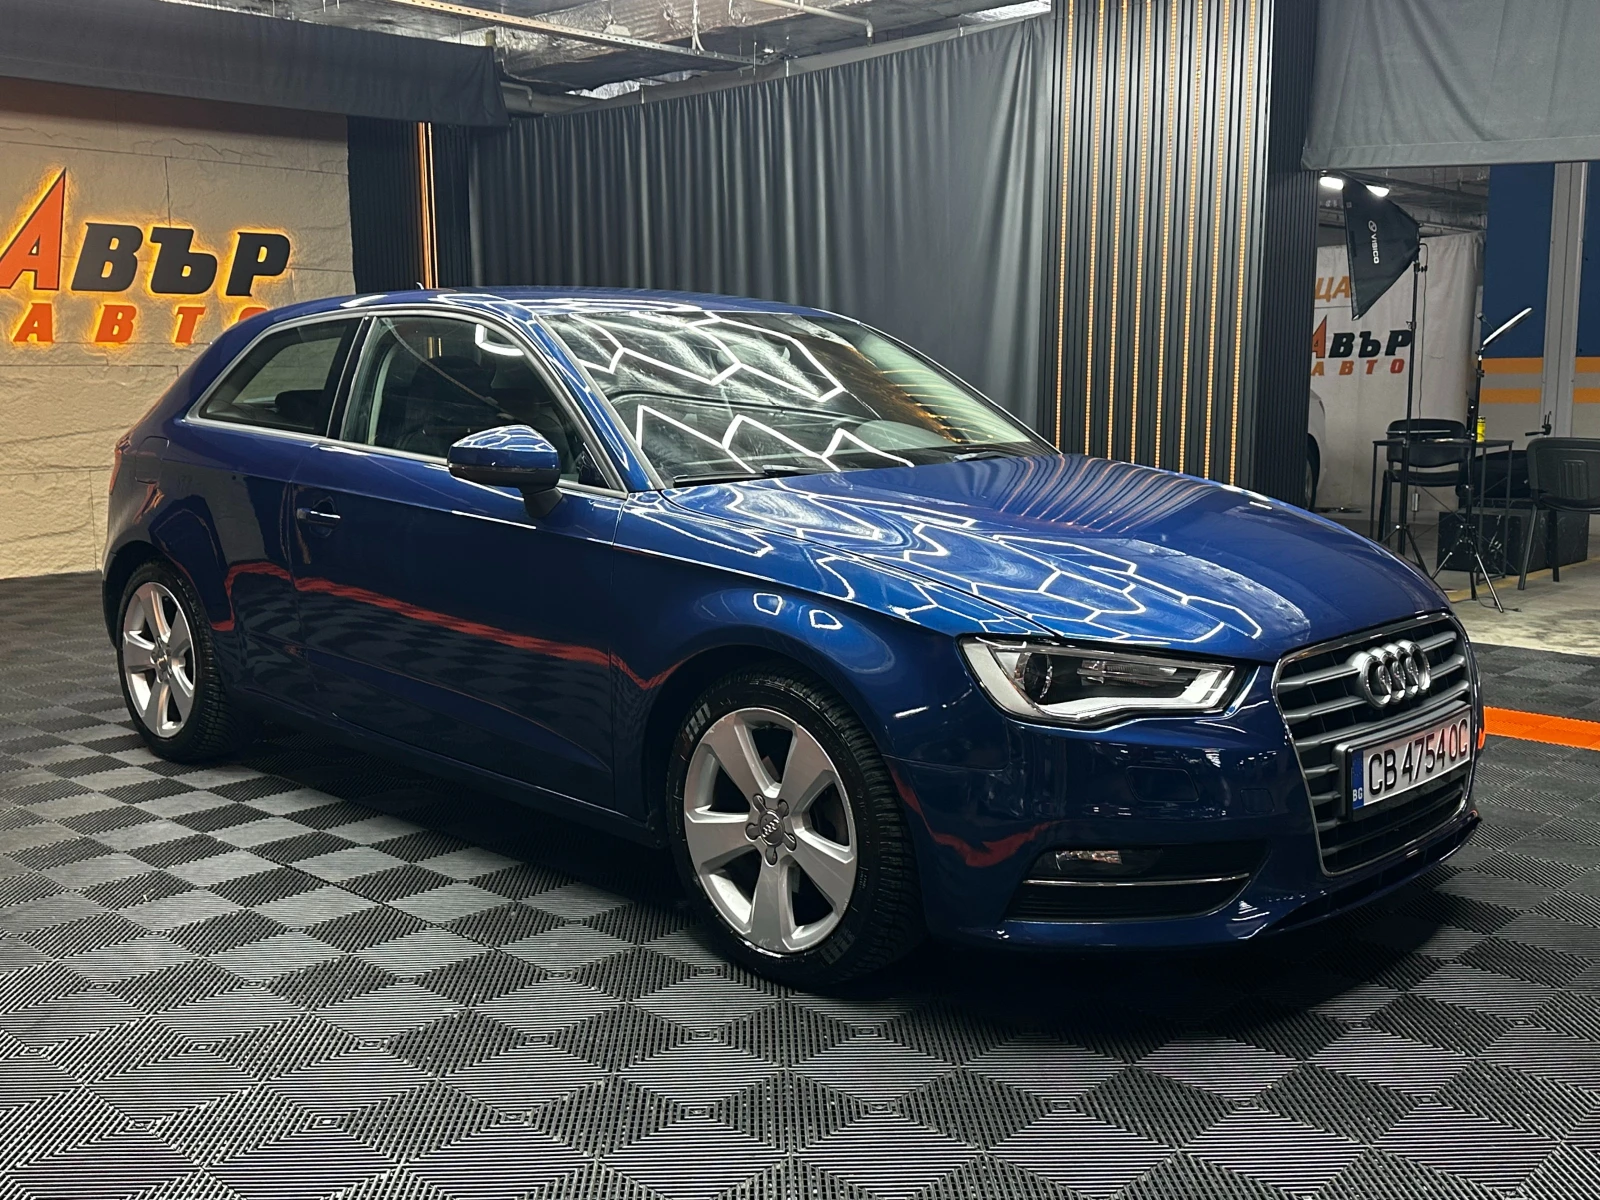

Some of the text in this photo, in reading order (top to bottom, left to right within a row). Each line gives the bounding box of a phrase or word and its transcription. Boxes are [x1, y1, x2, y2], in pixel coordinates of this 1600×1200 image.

[1371, 233, 1380, 264] VISICO
[1311, 358, 1405, 376] АВТО
[1368, 748, 1397, 796] CB
[1401, 728, 1446, 783] 4754
[1352, 787, 1363, 802] BG
